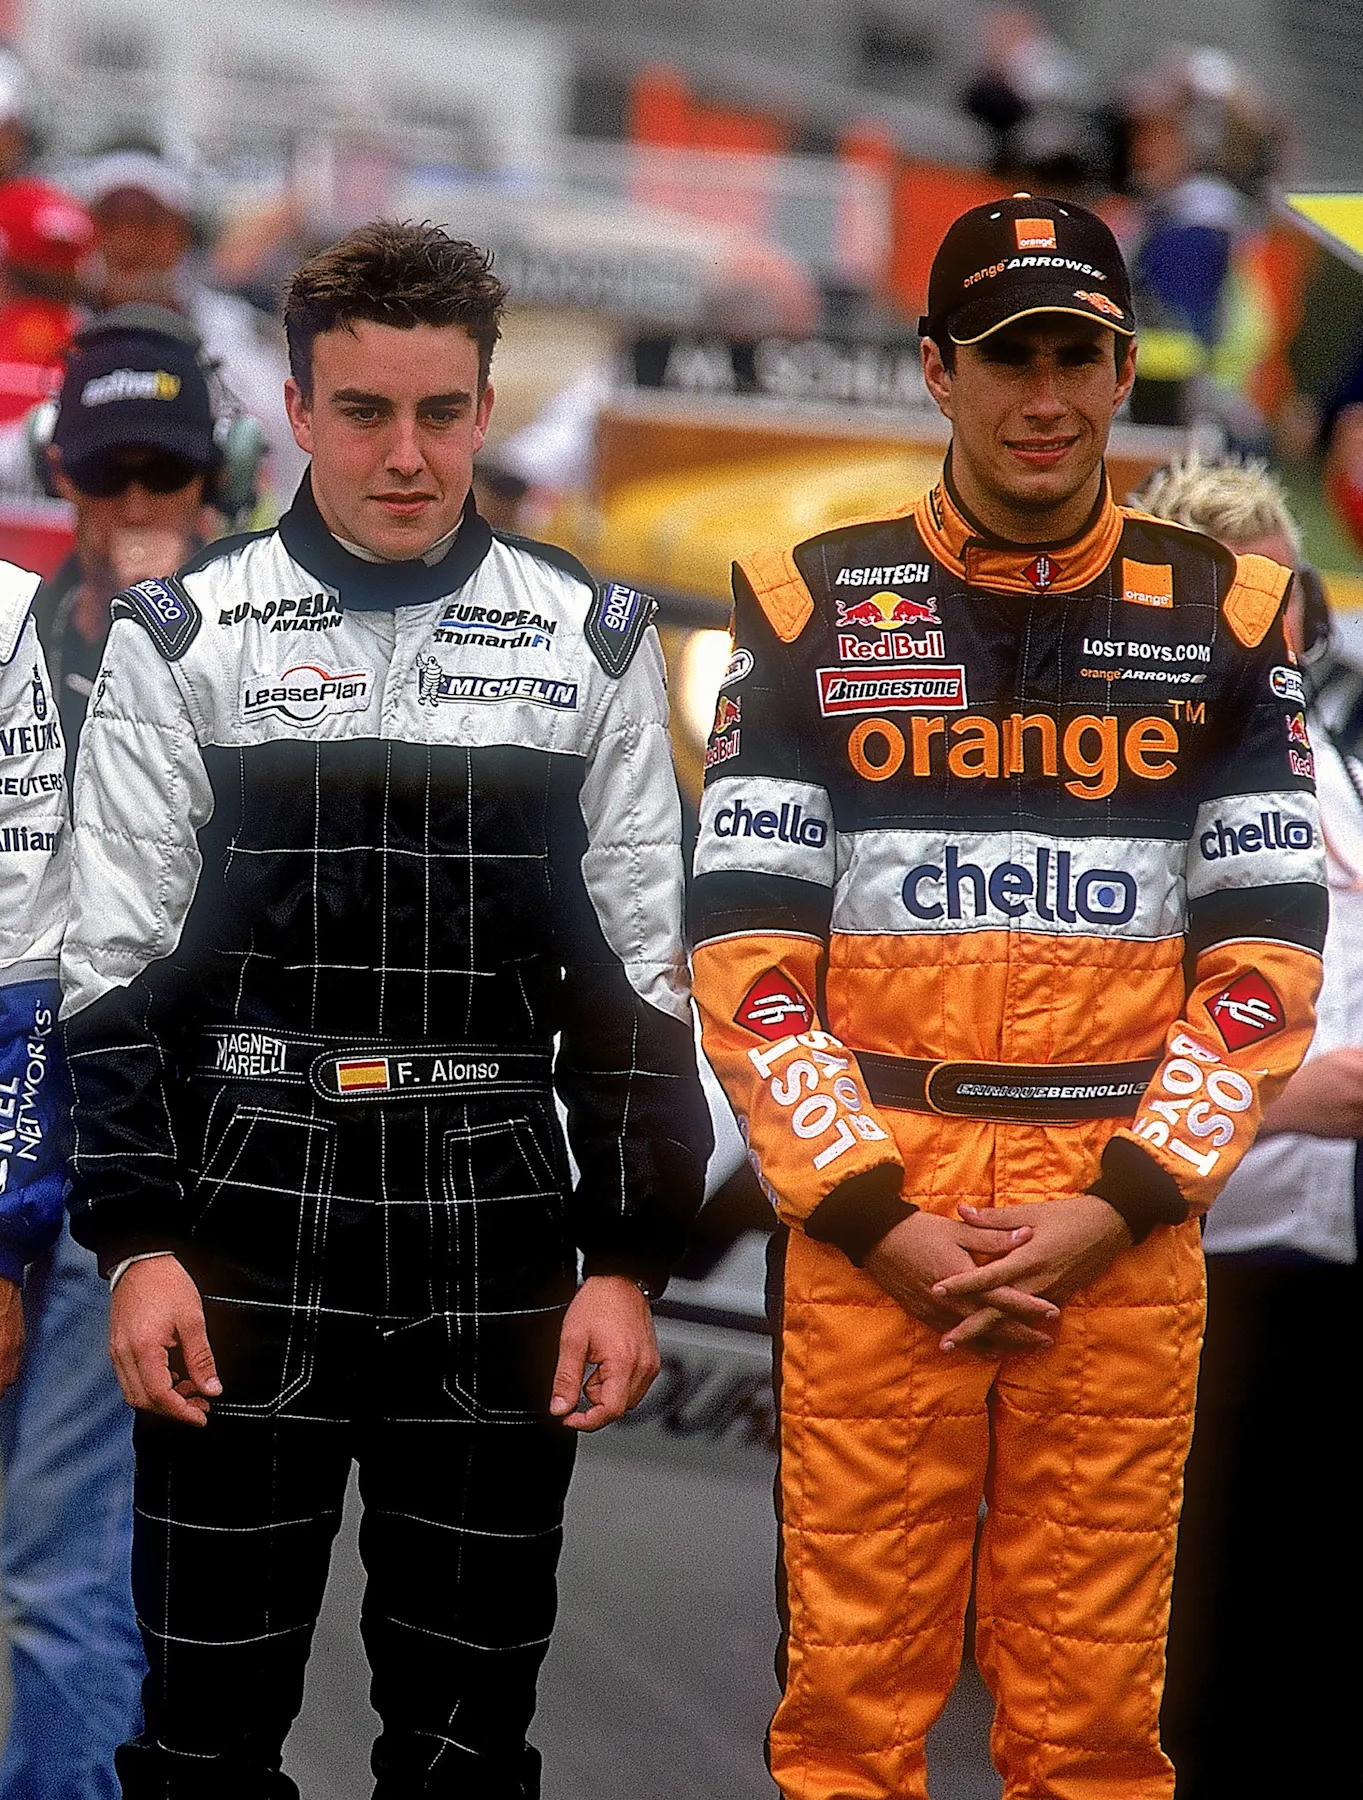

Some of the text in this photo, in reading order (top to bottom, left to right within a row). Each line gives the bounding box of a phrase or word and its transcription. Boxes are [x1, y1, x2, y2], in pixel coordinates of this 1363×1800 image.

[836, 563, 931, 587] ASIATECH
[270, 614, 344, 634] AVIATION
[442, 603, 558, 635] EUROPEAN
[839, 631, 945, 660] Red Bull
[1083, 638, 1211, 662] LOST BOYS.COM
[244, 680, 367, 709] LeasePlan
[446, 678, 575, 705] MICHELIN
[827, 679, 958, 701] BRIDGESTONE
[847, 713, 1180, 800] orange
[714, 800, 828, 849] chello
[1199, 811, 1313, 861] chello
[901, 845, 1138, 926] chello
[15, 1008, 53, 1162] NETWORKS
[397, 1059, 500, 1084] F. Alonso
[796, 1030, 890, 1141] BOYS
[747, 1034, 857, 1171] LOST
[1168, 1069, 1254, 1177] OST
